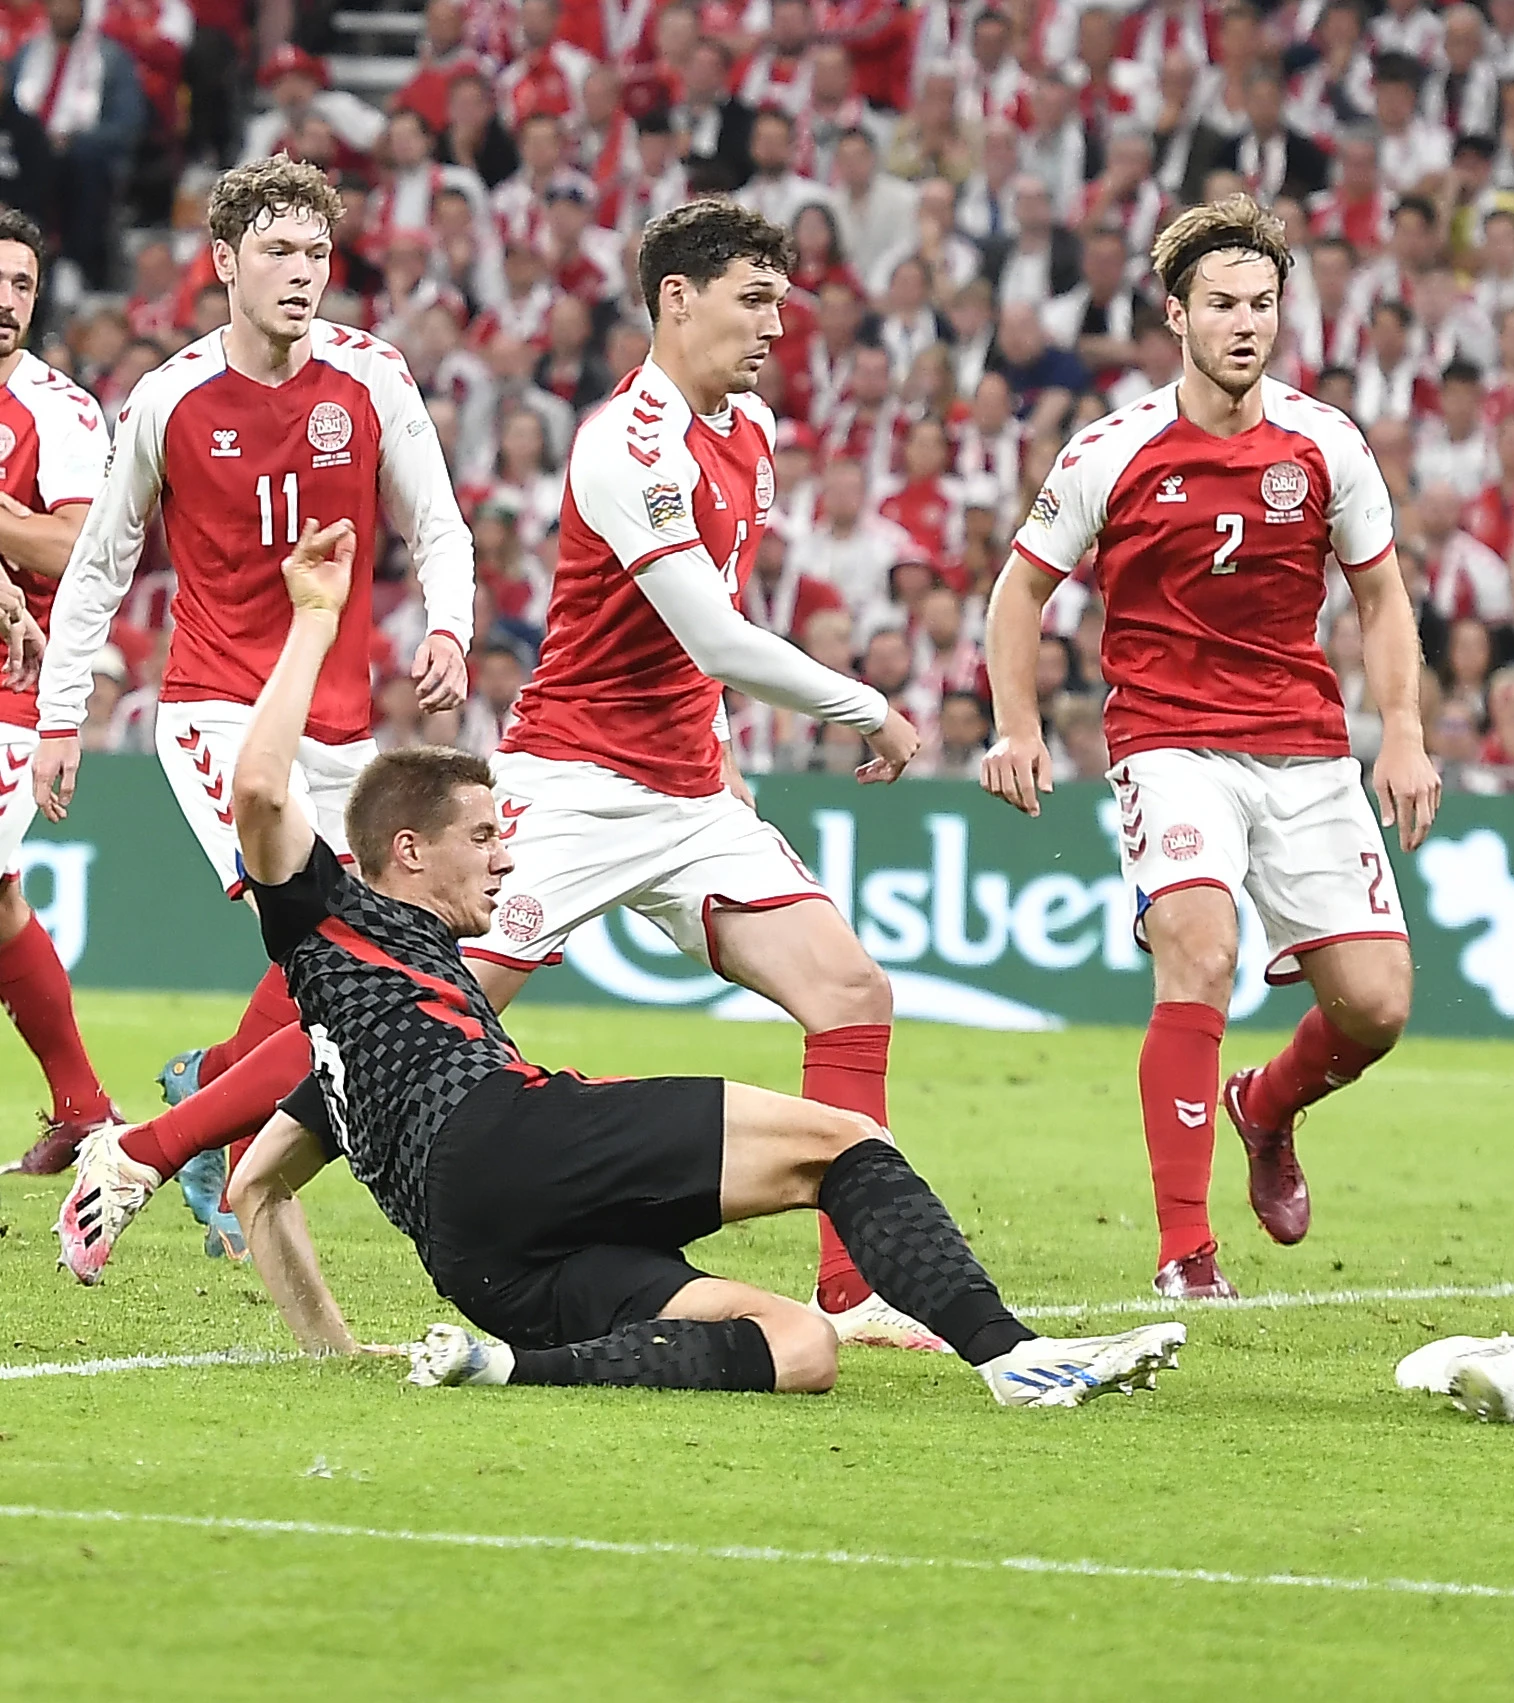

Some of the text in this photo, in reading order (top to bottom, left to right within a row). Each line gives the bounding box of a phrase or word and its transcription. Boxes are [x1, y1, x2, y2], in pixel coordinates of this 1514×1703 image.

[256, 472, 299, 546] 11
[1211, 514, 1244, 575] 2
[1360, 852, 1391, 915] 2
